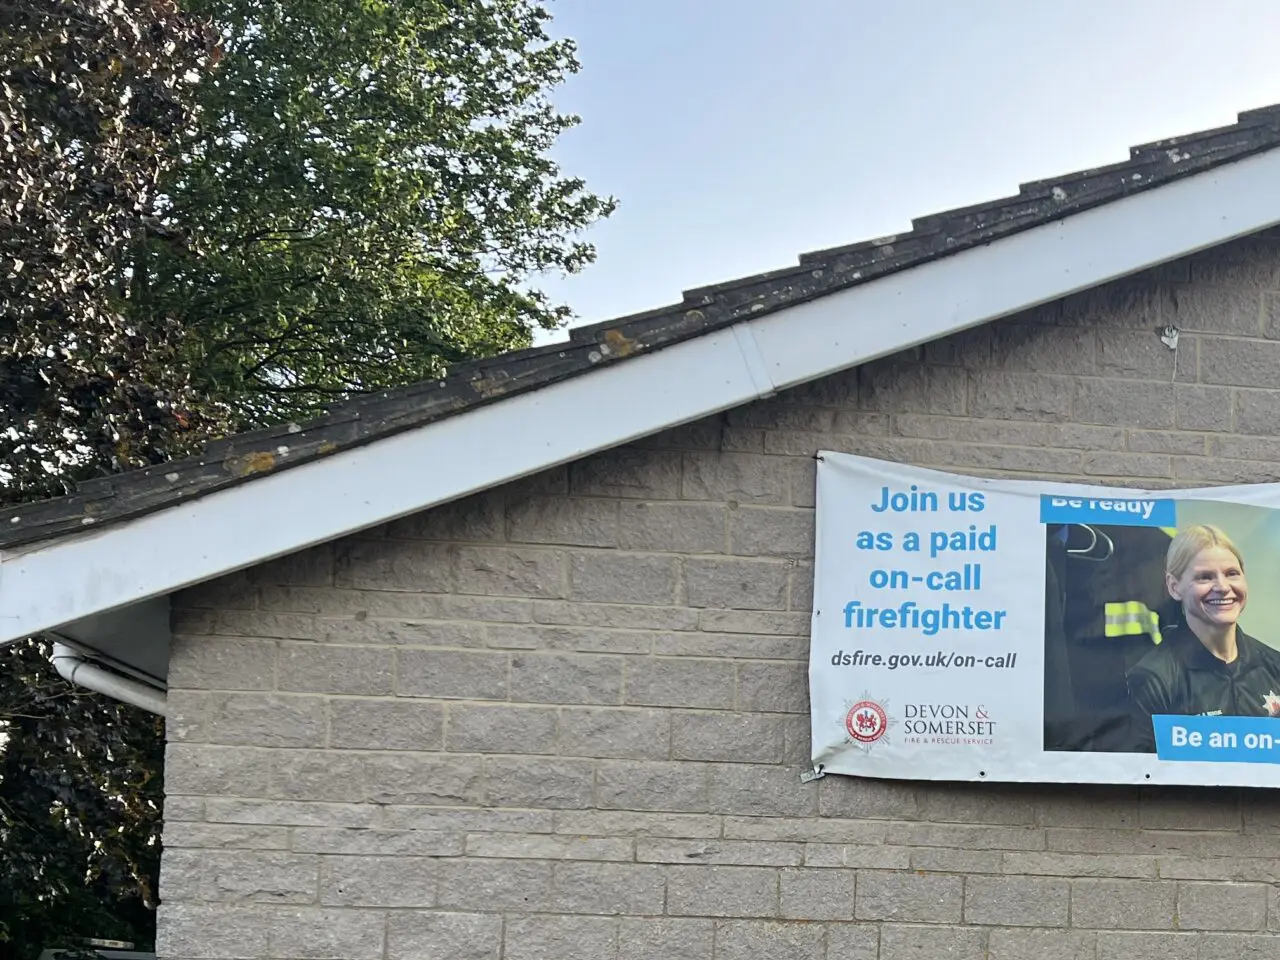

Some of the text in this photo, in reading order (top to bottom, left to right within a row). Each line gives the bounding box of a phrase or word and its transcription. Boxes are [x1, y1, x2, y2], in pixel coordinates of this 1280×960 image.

[870, 485, 985, 514] Join us
[1089, 499, 1156, 520] ready
[856, 523, 997, 558] as a paid
[869, 562, 982, 592] on-call
[842, 599, 1007, 636] firefighter
[830, 649, 1017, 670] dsfire.gov.uk/on-call
[904, 704, 989, 719] DEVON &
[904, 720, 996, 736] SOMERSET
[1171, 725, 1203, 748] Be
[1209, 731, 1237, 749] an
